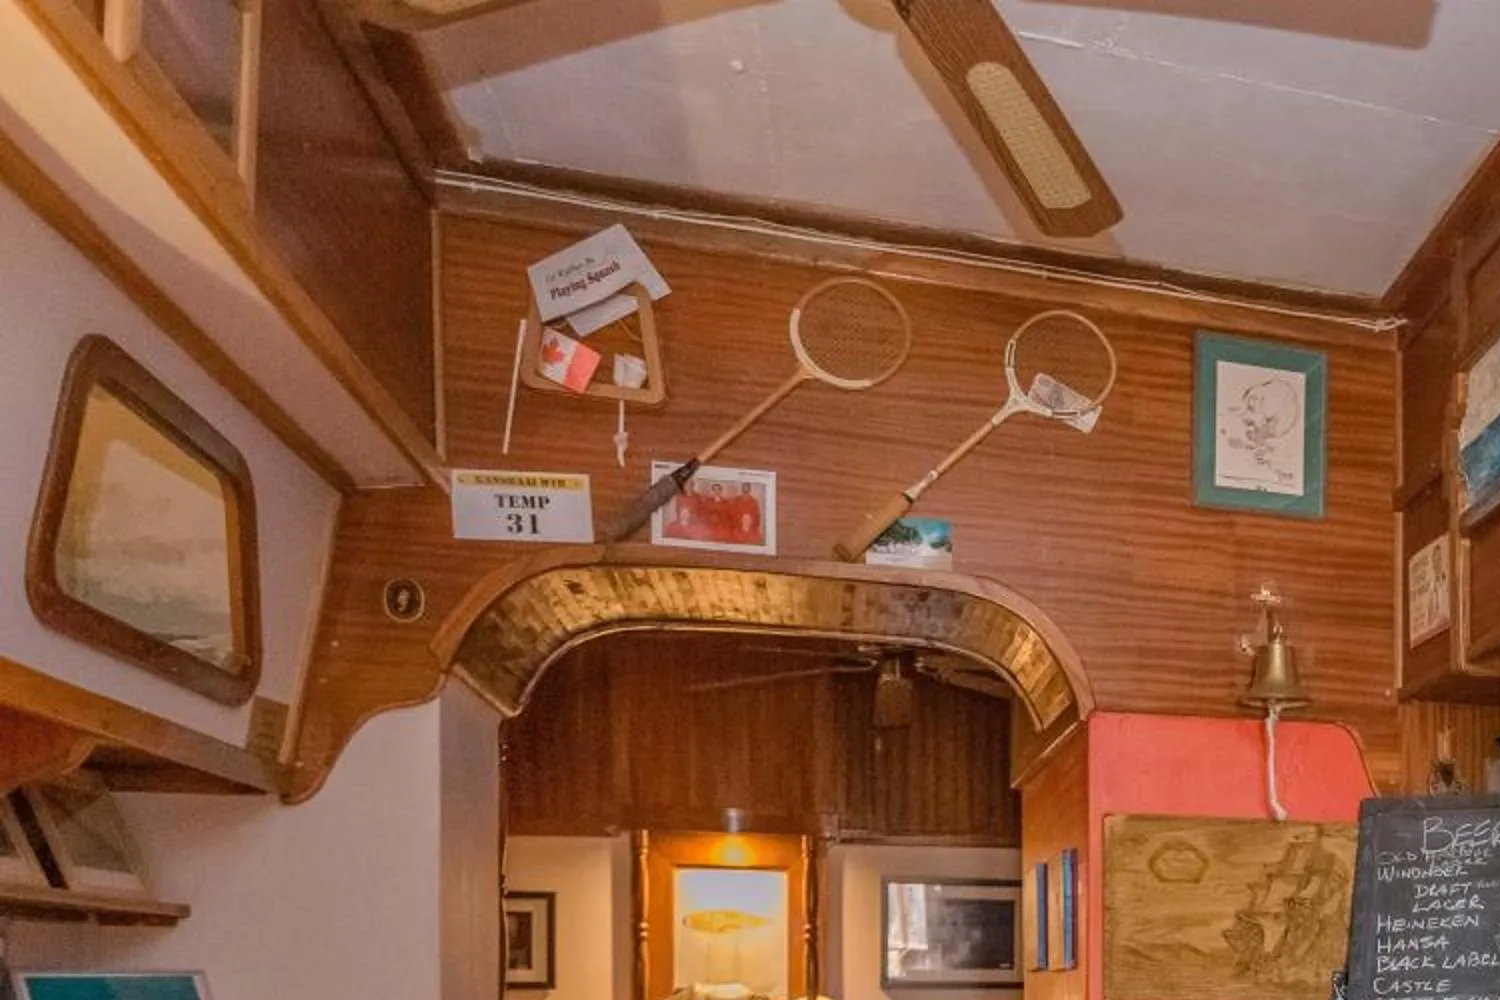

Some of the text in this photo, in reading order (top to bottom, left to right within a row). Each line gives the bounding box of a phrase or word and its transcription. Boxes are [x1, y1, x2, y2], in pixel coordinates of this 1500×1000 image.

[549, 258, 622, 301] Playing Squash
[494, 493, 551, 510] TEMP
[506, 513, 540, 535] 31
[1413, 881, 1473, 899] DRAFT
[1412, 893, 1486, 913] LAGER
[1375, 912, 1481, 935] HEINEKEN
[1376, 932, 1451, 954] HANSA
[1375, 953, 1436, 973] BLACK
[1441, 950, 1500, 969] LABEL
[1372, 976, 1452, 996] CASTLE
